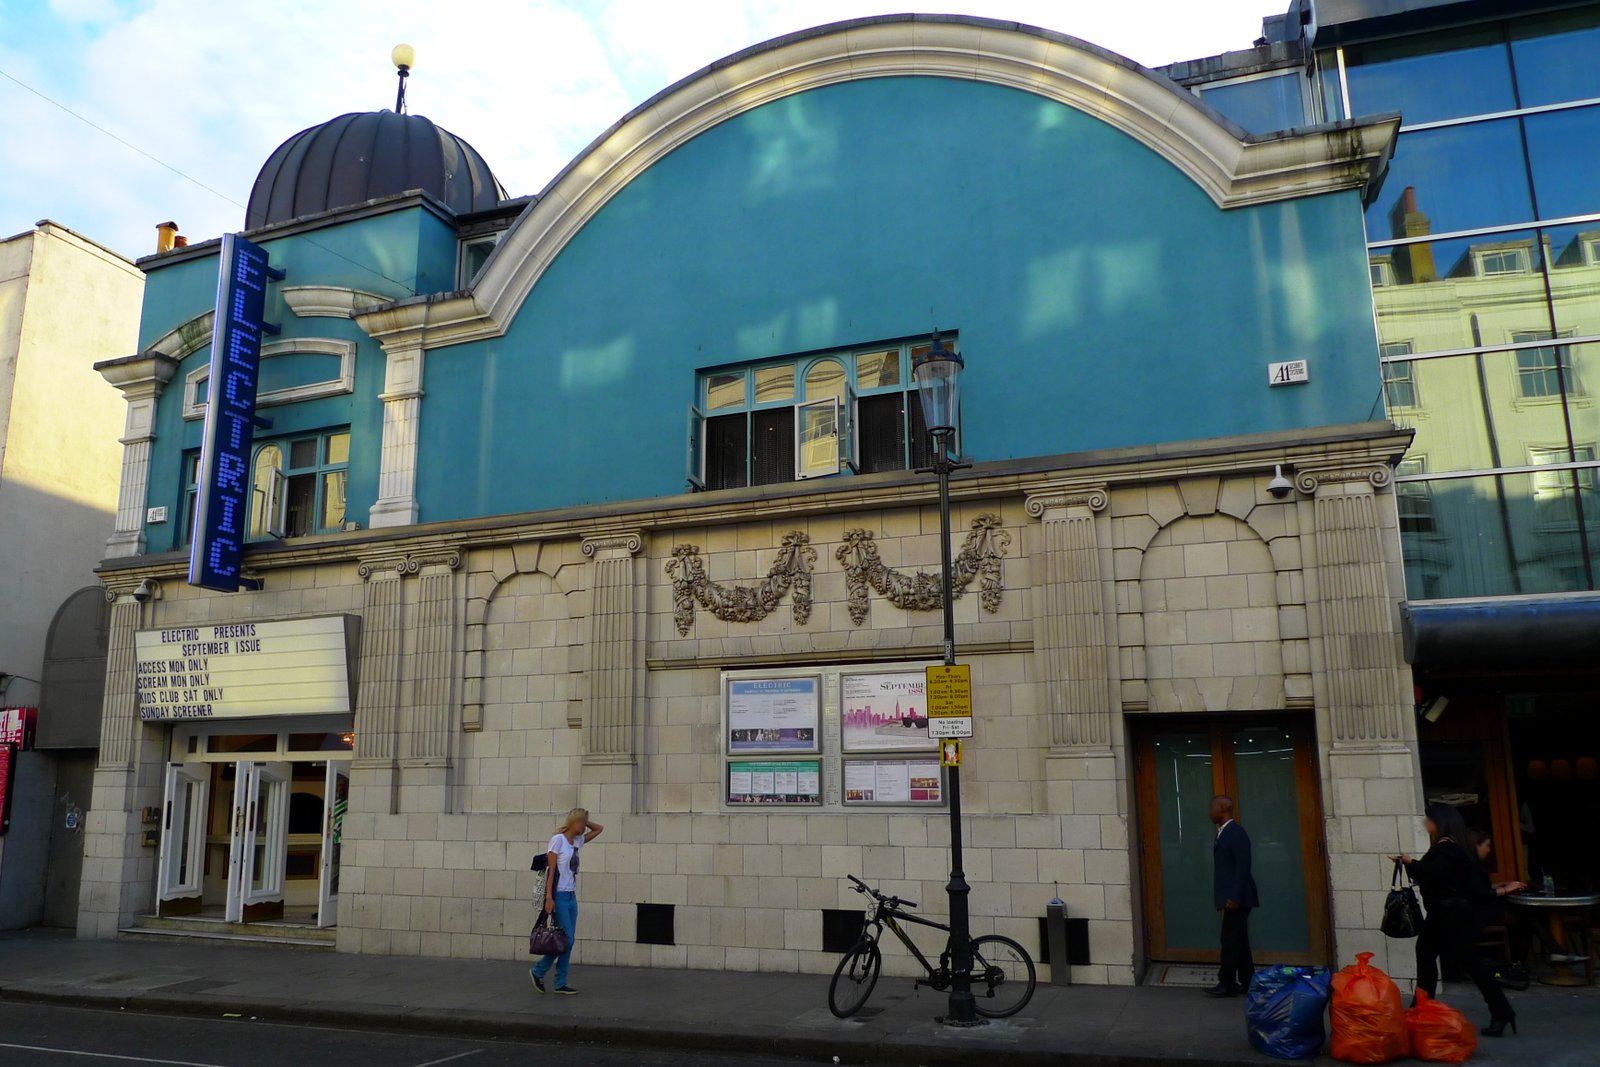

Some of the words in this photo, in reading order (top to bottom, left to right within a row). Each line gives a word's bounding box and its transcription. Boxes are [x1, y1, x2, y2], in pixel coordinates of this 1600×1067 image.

[209, 248, 263, 577] ELECTRIC
[161, 628, 199, 643] ELECTRIC
[214, 624, 256, 639] PRESENTS
[182, 641, 229, 656] SEPTEMBER
[236, 639, 261, 654] ISSUE
[138, 660, 166, 674] ACCESS
[169, 660, 185, 673] MON
[188, 658, 209, 671] ONLY
[137, 675, 168, 689] SCREAM
[170, 675, 187, 688] MON
[190, 673, 210, 687] ONLY
[753, 681, 792, 689] ELECTRIC
[880, 682, 926, 691] SEPTEMBE
[140, 691, 156, 704] KIDS
[160, 690, 179, 703] CLUB
[183, 689, 198, 702] SAT
[203, 688, 223, 701] ONLY
[141, 705, 169, 719] SUNDAY
[172, 704, 213, 718] SCREENER
